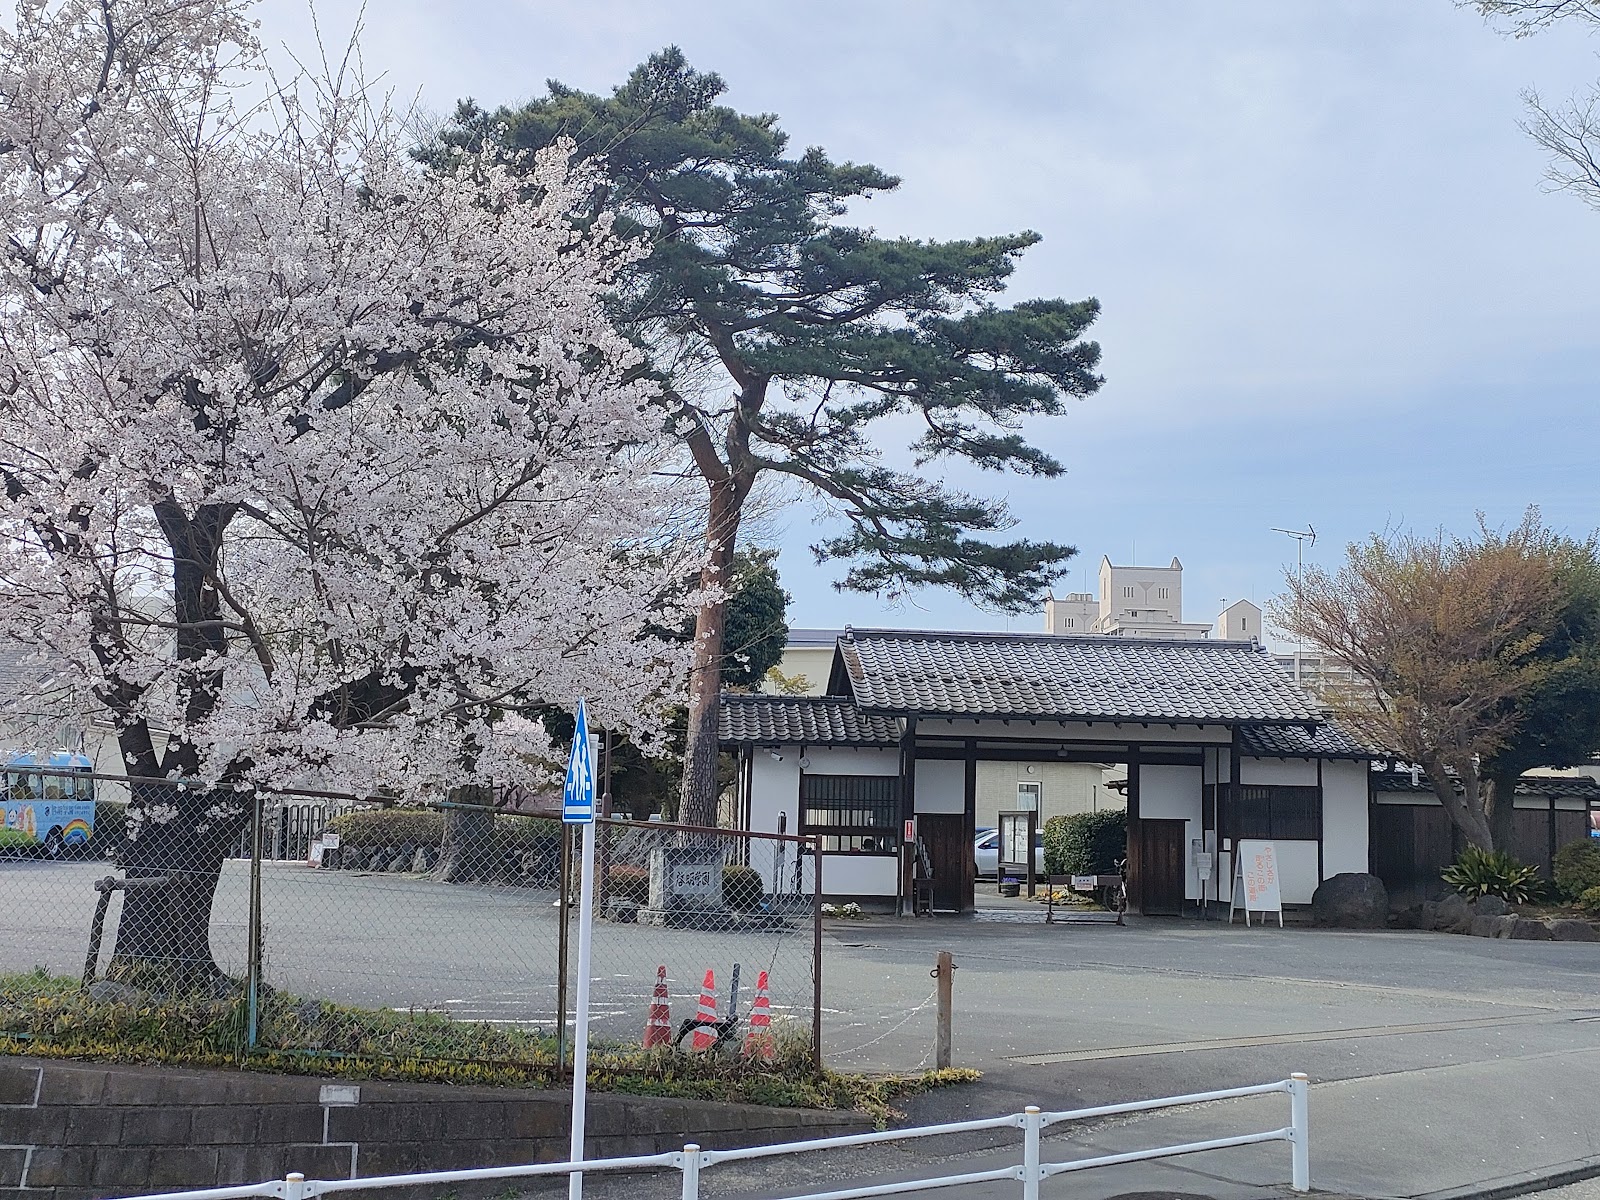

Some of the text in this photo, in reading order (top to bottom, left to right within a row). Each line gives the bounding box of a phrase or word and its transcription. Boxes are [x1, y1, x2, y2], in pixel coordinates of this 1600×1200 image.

[1263, 847, 1274, 884] やさしさが
